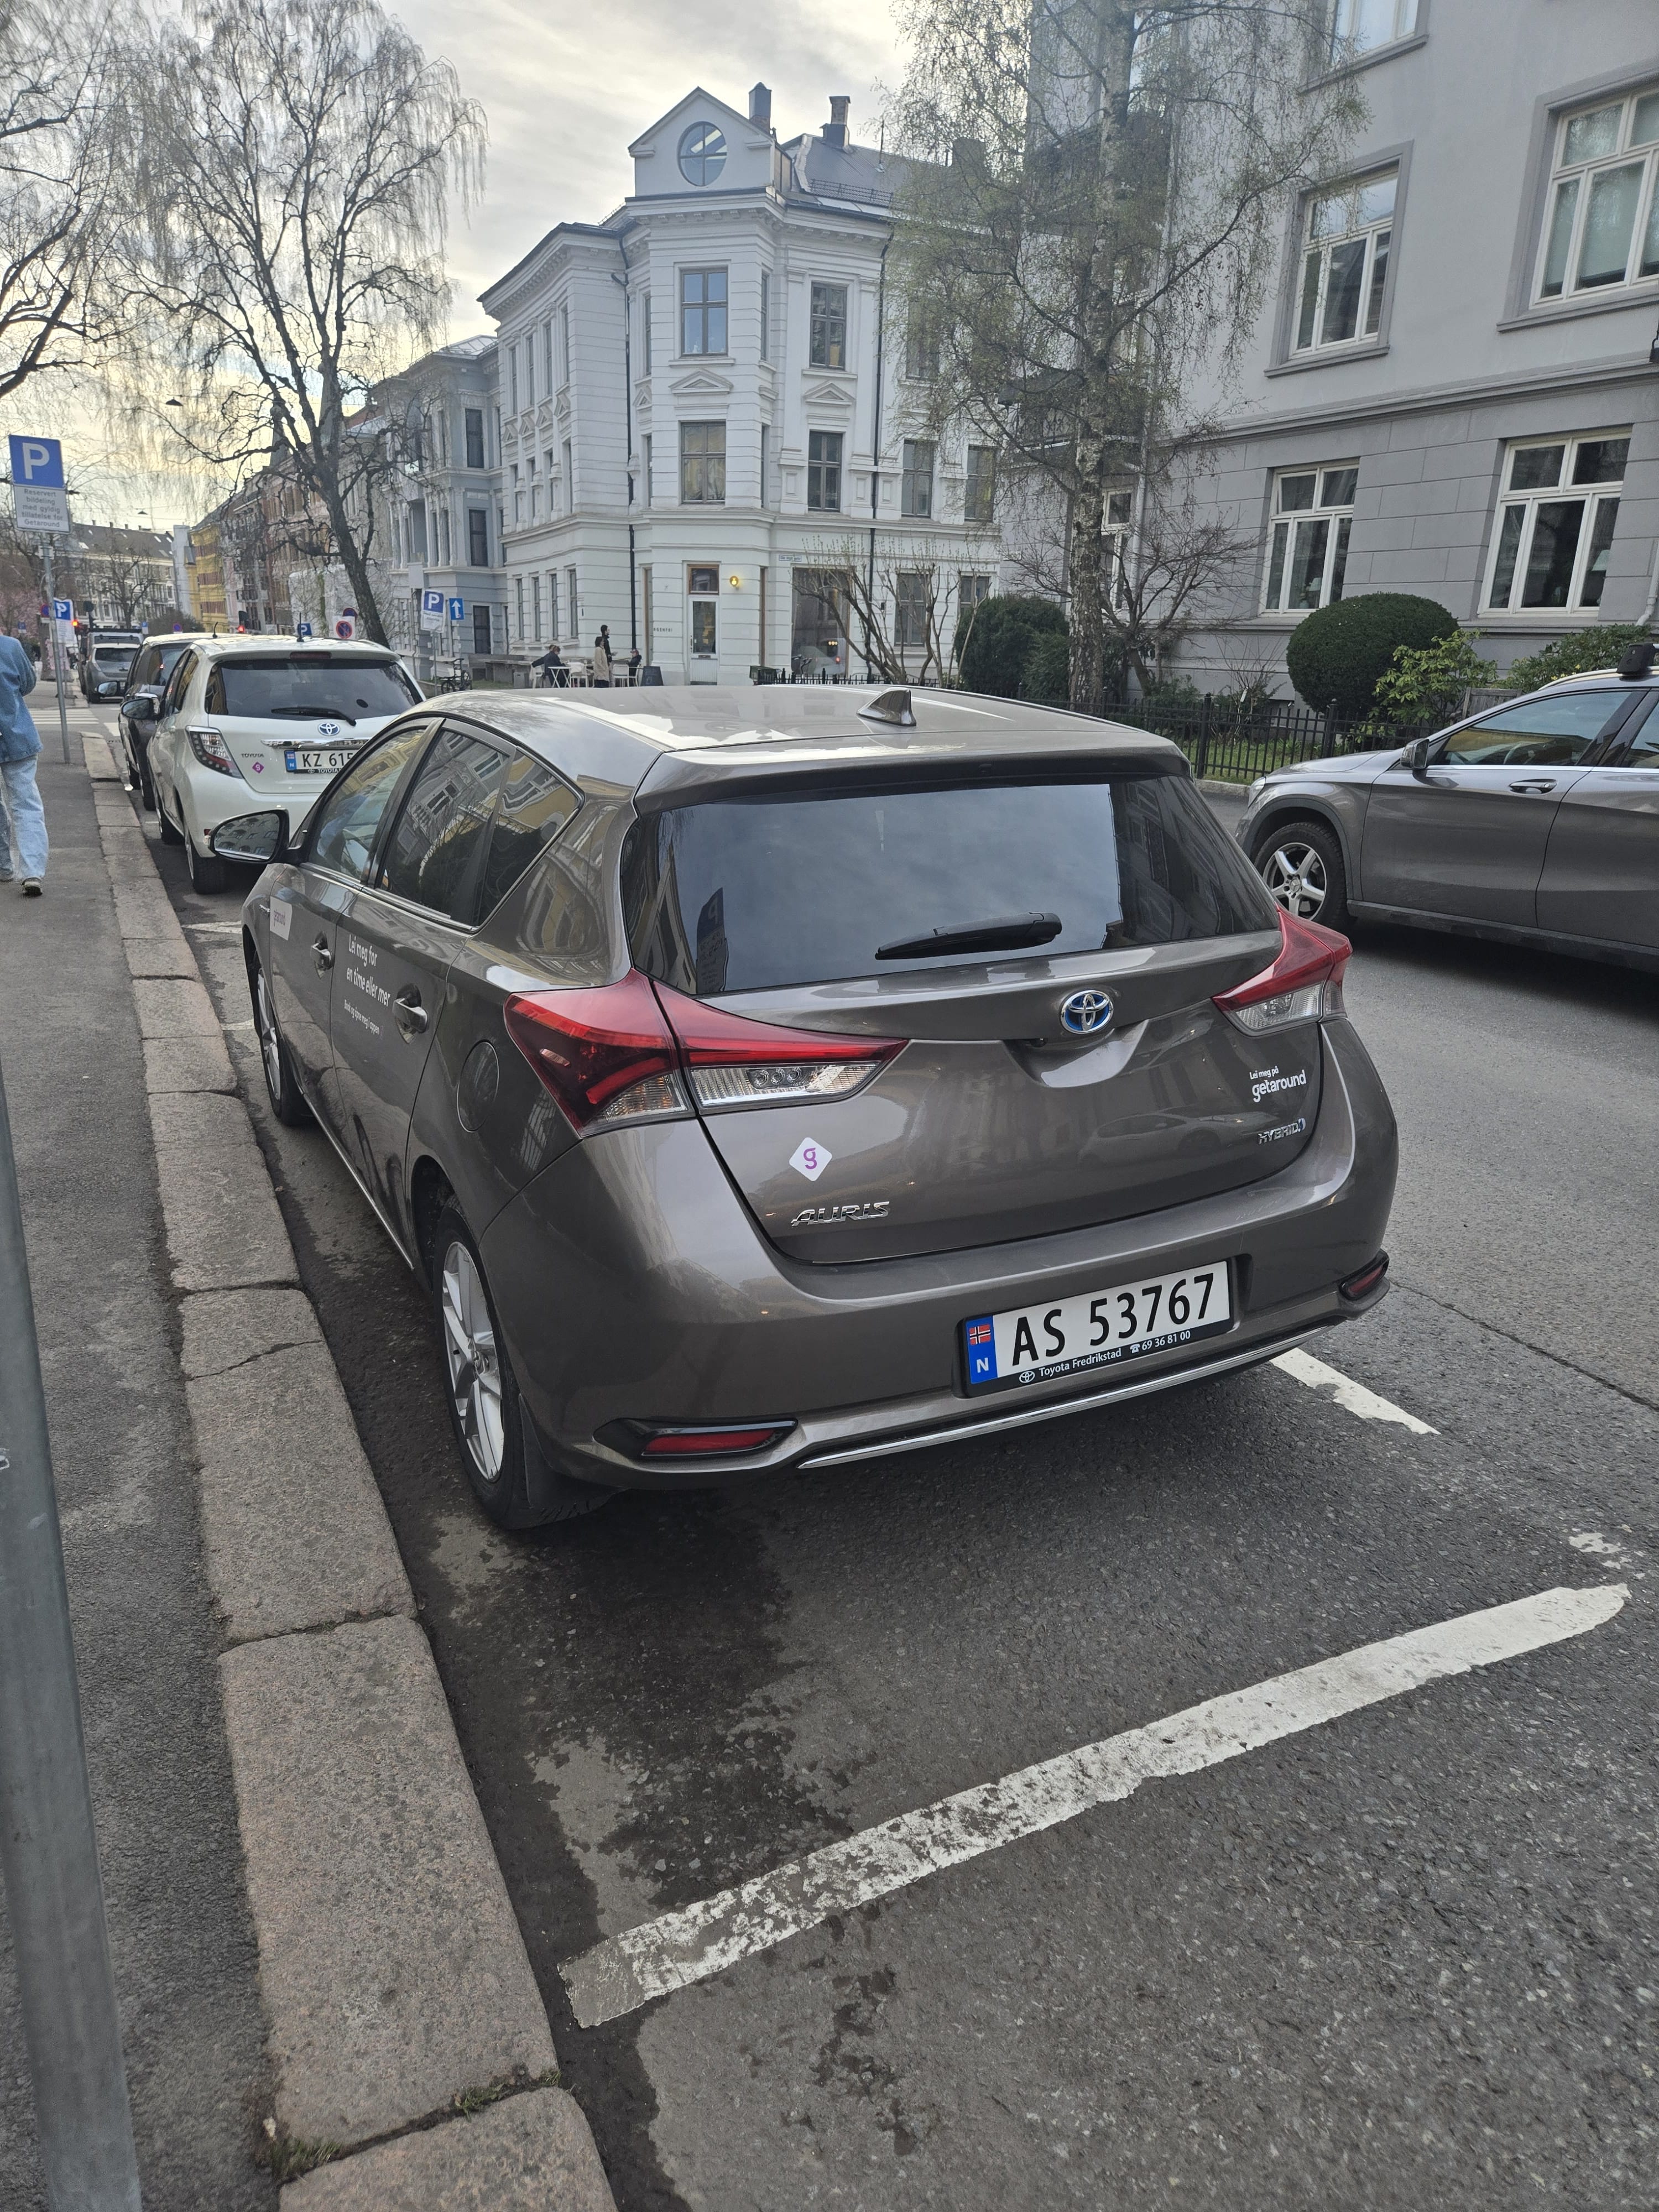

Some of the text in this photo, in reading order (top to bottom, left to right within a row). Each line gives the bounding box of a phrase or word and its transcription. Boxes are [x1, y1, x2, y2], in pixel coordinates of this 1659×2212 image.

[22, 442, 50, 479] P
[26, 497, 55, 505] bildeling
[40, 506, 60, 514] gyldig
[24, 518, 60, 527] Getaround
[56, 603, 67, 617] P
[427, 593, 440, 609] P
[300, 625, 307, 637] P
[302, 754, 322, 767] KZ
[356, 943, 368, 967] meg
[368, 945, 377, 967] for
[346, 967, 390, 1006] en time eller mer
[1249, 1066, 1279, 1079] Lei meg på
[1252, 1070, 1307, 1103] getaround
[1258, 1122, 1299, 1144] HYBRID
[803, 1147, 817, 1170] g
[791, 1201, 890, 1227] AURIS
[1012, 1272, 1214, 1366] AS 53767
[1039, 1331, 1191, 1378] Toyota Fredrikstad 69 36 81 00
[977, 1358, 989, 1373] N
